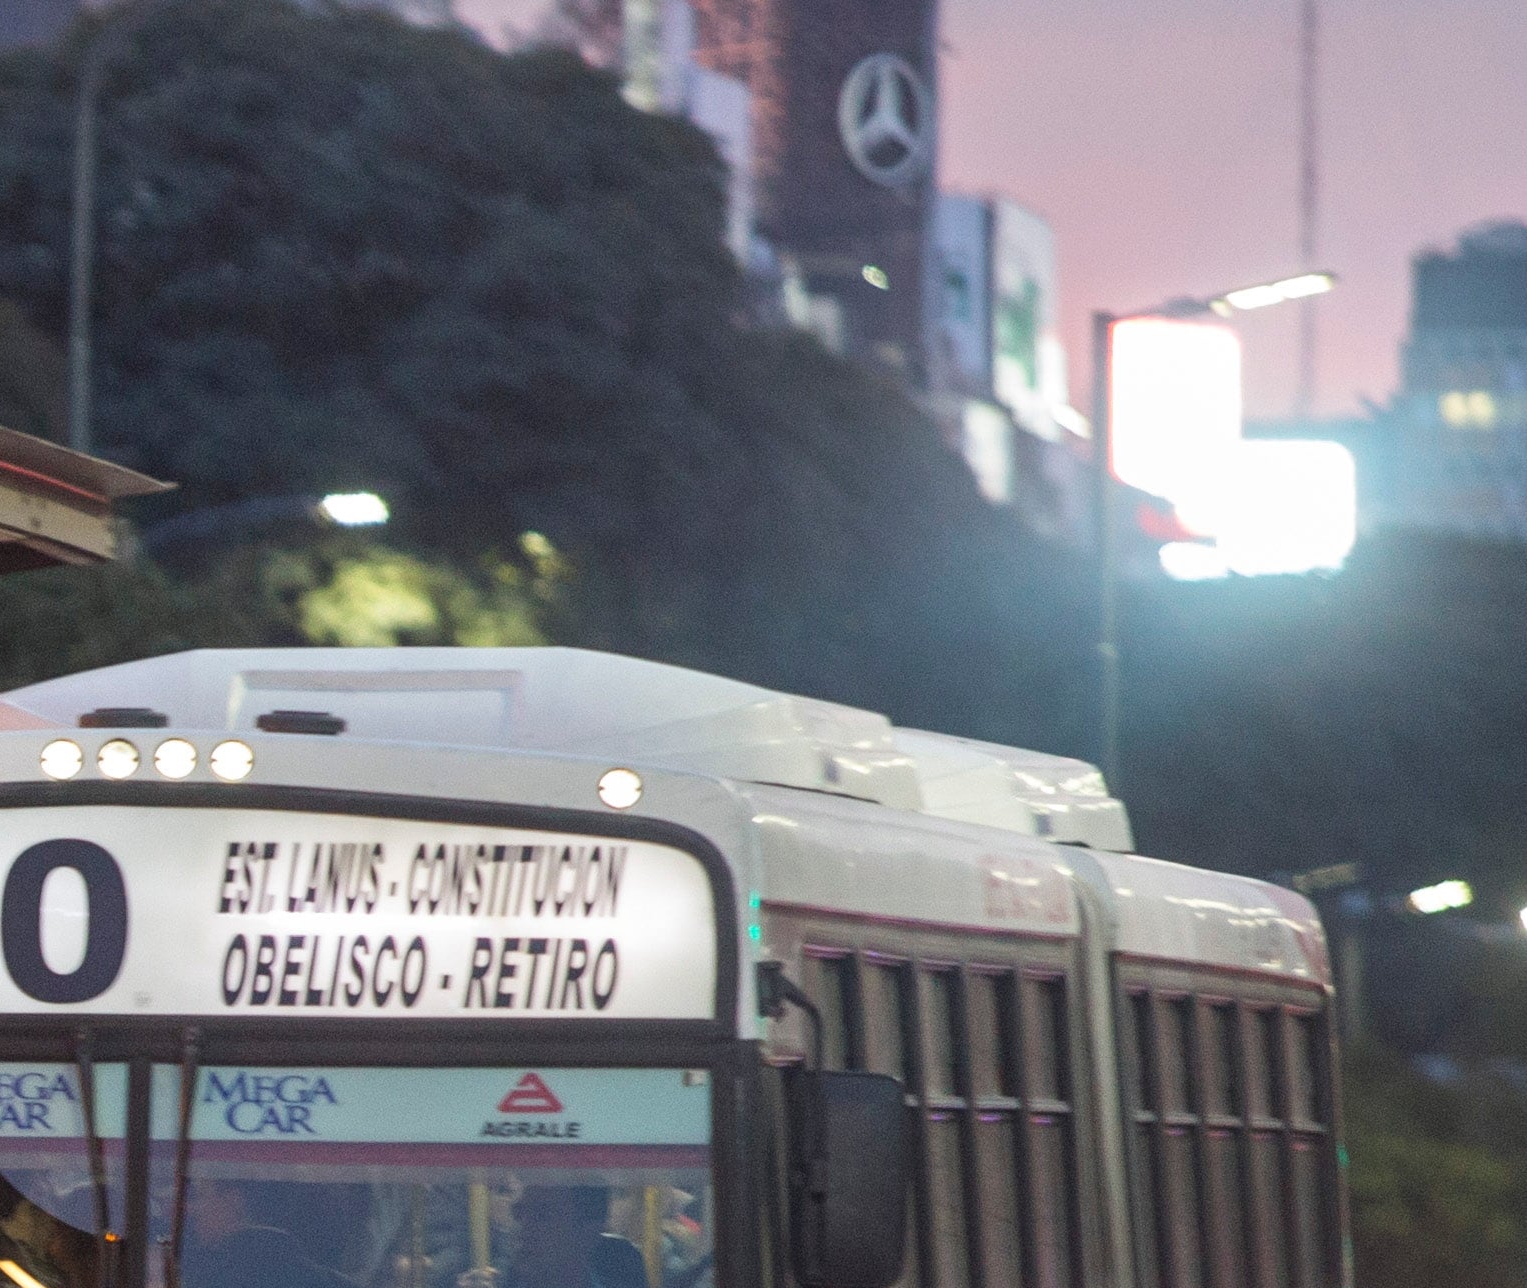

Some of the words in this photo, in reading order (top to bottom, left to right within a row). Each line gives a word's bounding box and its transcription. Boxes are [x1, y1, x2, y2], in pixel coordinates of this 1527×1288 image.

[286, 842, 384, 914] LANUS
[408, 843, 628, 917] CONSTITUCION
[222, 934, 426, 1008] OBELISCO
[464, 938, 618, 1009] RETIRO
[202, 1072, 338, 1104] MEGA
[225, 1101, 317, 1134] CAR
[479, 1120, 581, 1139] AGRALE
